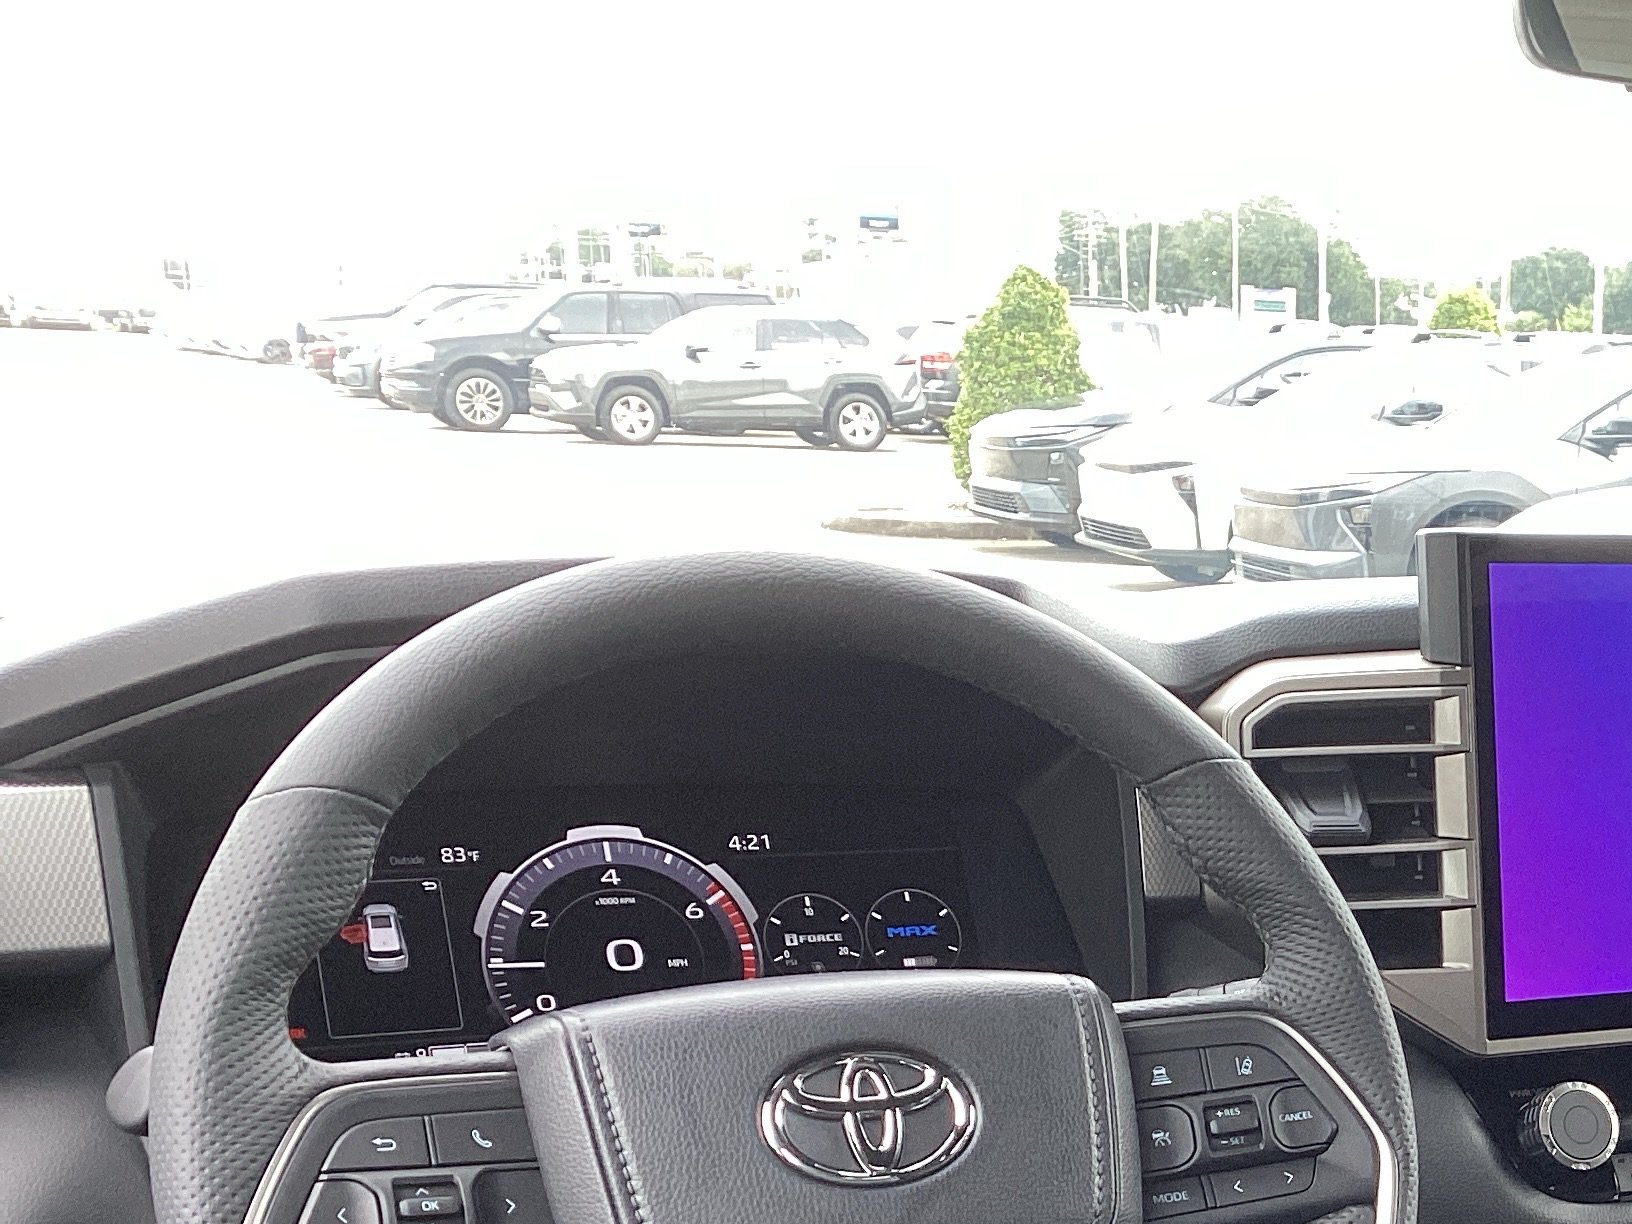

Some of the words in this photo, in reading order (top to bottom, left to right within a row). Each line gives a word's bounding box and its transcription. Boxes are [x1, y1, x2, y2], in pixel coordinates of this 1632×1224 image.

[728, 834, 770, 851] 4:21
[600, 869, 621, 885] 4
[530, 910, 549, 927] 2
[685, 903, 704, 919] 6
[886, 924, 938, 938] MAX
[605, 938, 644, 971] 0
[1278, 1110, 1313, 1122] CANCEL
[1152, 1190, 1189, 1204] MODE
[421, 1200, 439, 1211] OK
